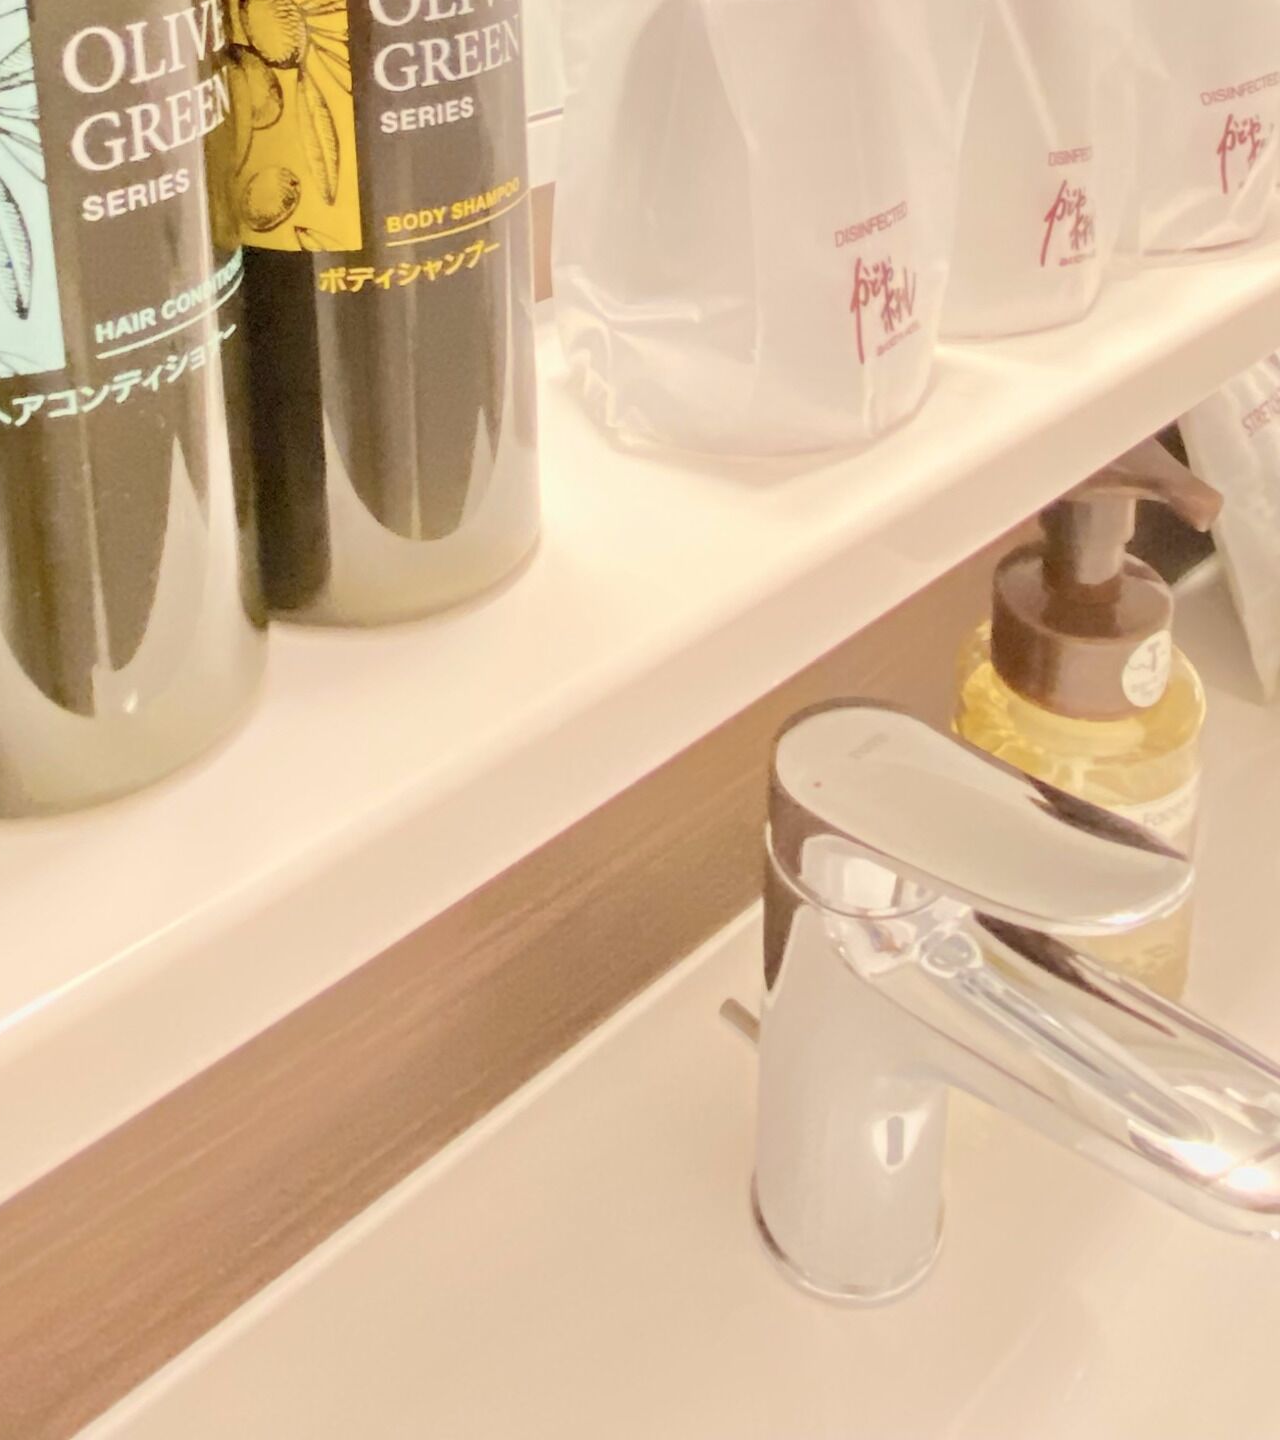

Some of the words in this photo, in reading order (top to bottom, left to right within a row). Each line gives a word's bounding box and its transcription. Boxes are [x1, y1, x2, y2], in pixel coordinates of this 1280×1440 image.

[373, 13, 520, 93] GREEN
[70, 64, 232, 172] GREEN
[379, 95, 476, 134] SERIES
[81, 167, 191, 222] SERIES
[385, 205, 448, 234] BODY
[450, 176, 521, 221] SHAMPOO
[94, 306, 157, 345] HAIR
